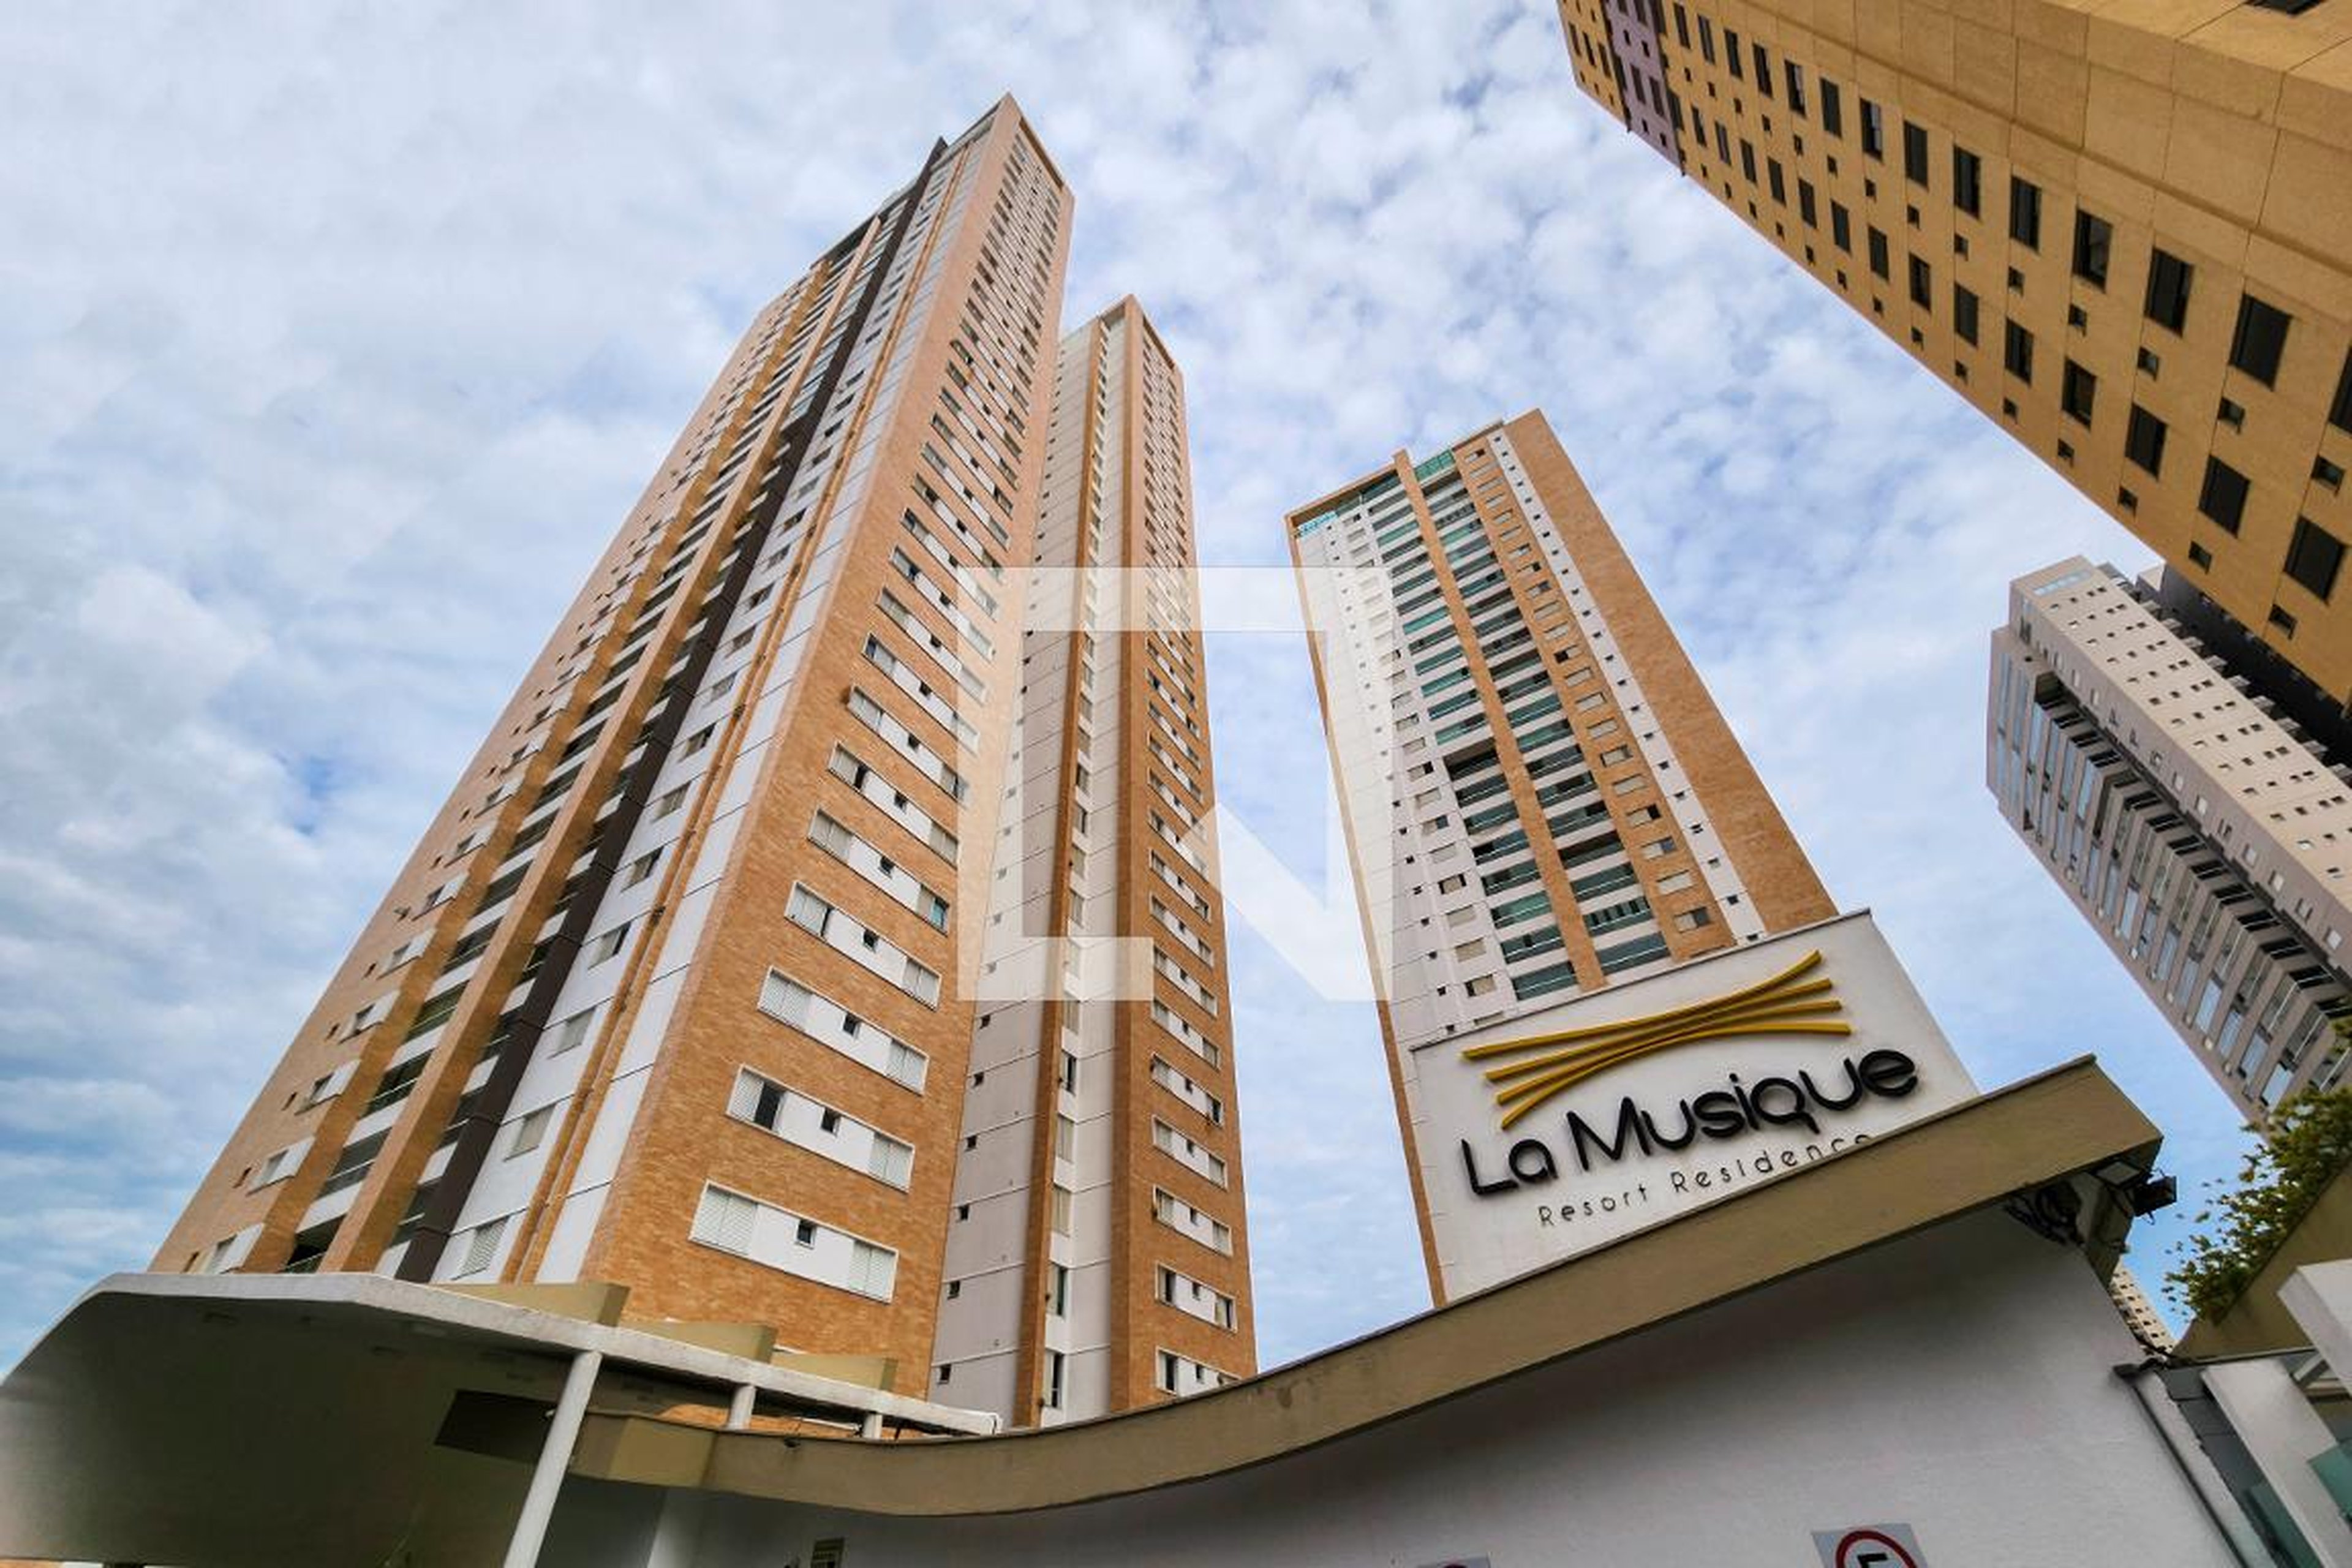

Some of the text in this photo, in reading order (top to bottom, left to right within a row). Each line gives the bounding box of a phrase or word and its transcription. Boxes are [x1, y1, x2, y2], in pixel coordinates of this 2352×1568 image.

[1461, 1049, 1918, 1195] La Musique
[1539, 1184, 1646, 1226] Resort
